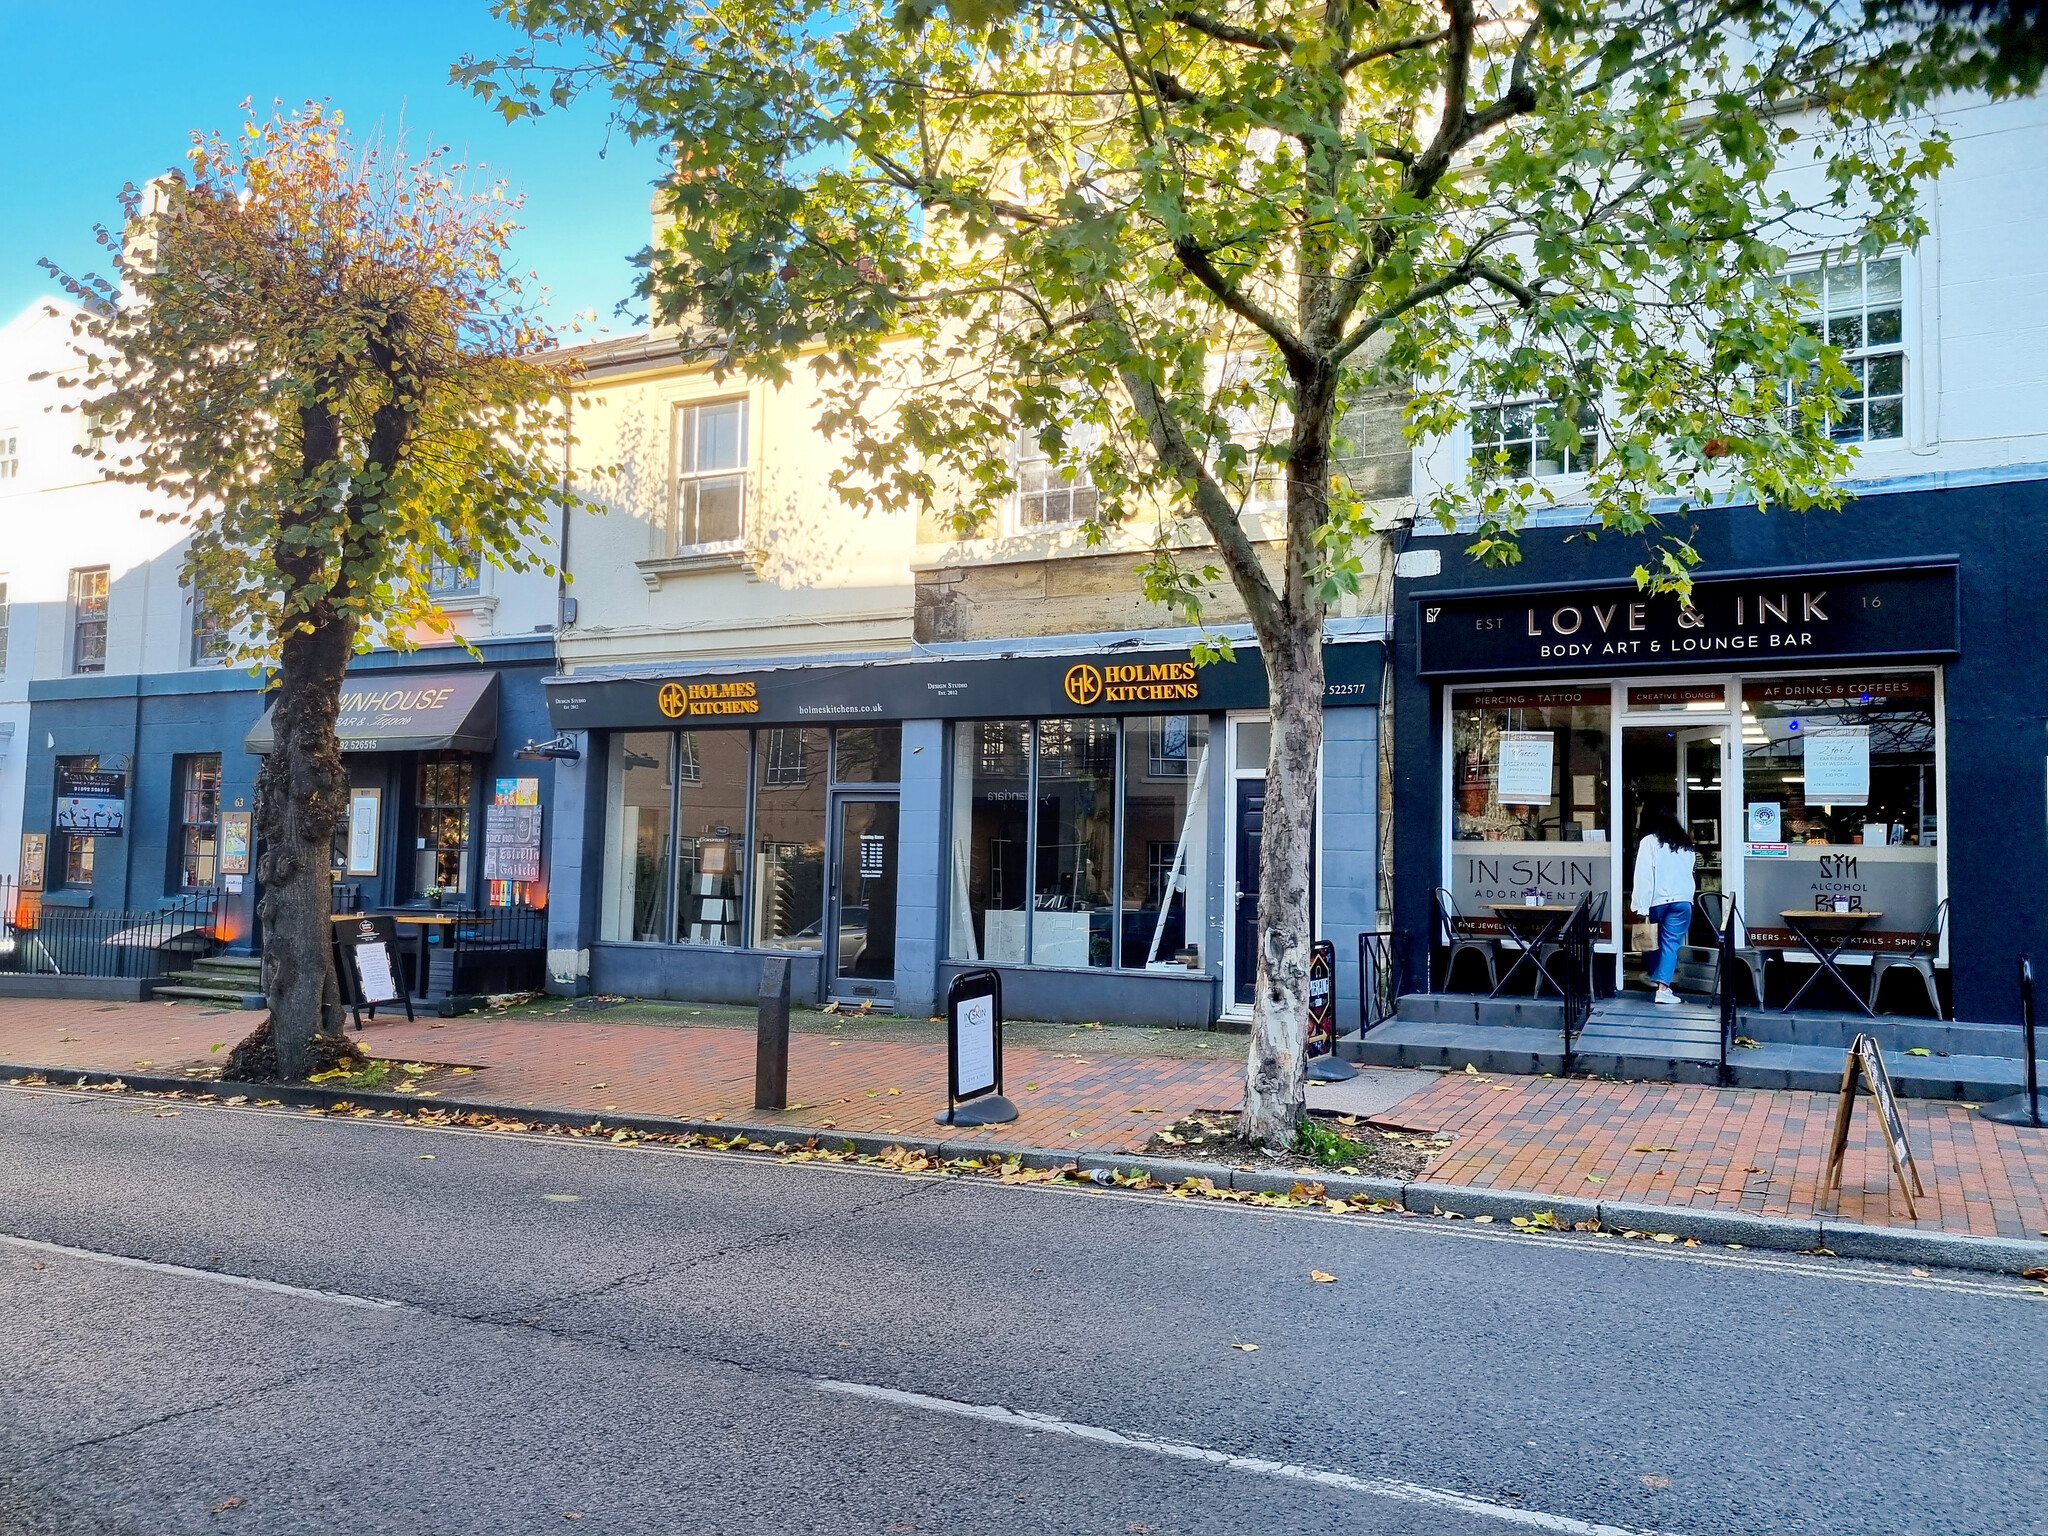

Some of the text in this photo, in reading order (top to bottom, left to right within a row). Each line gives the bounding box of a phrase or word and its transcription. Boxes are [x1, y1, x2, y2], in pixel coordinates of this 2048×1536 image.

[1861, 596, 1882, 608] 16
[1528, 591, 1829, 636] LOVE & INK
[1476, 618, 1503, 630] EST
[1541, 633, 1812, 657] BODY ART & LOUNGE BAR
[1104, 662, 1196, 683] HOLMES
[688, 682, 756, 699] HOLMES
[1105, 683, 1198, 702] KITCHENS
[1329, 684, 1365, 695] 522577
[1765, 682, 1909, 696] AF DRINKS & COFFEES
[1475, 695, 1525, 705] PIERCING
[1538, 693, 1582, 703] TATTOO
[1636, 692, 1716, 701] CREATIVE LOUNGE
[689, 700, 759, 715] KITCHENS
[799, 703, 883, 714] holmeskitchens.co.uk
[335, 713, 412, 729] BAR & Tapas
[350, 740, 377, 750] 526515
[234, 797, 244, 808] 63
[500, 847, 540, 861] Estrella
[500, 863, 537, 877] Galicia
[1469, 859, 1592, 886] IN SKIN
[1810, 883, 1868, 892] ALCOHOL
[1750, 933, 1779, 941] BEERS
[1830, 936, 1884, 945] COKTAILS
